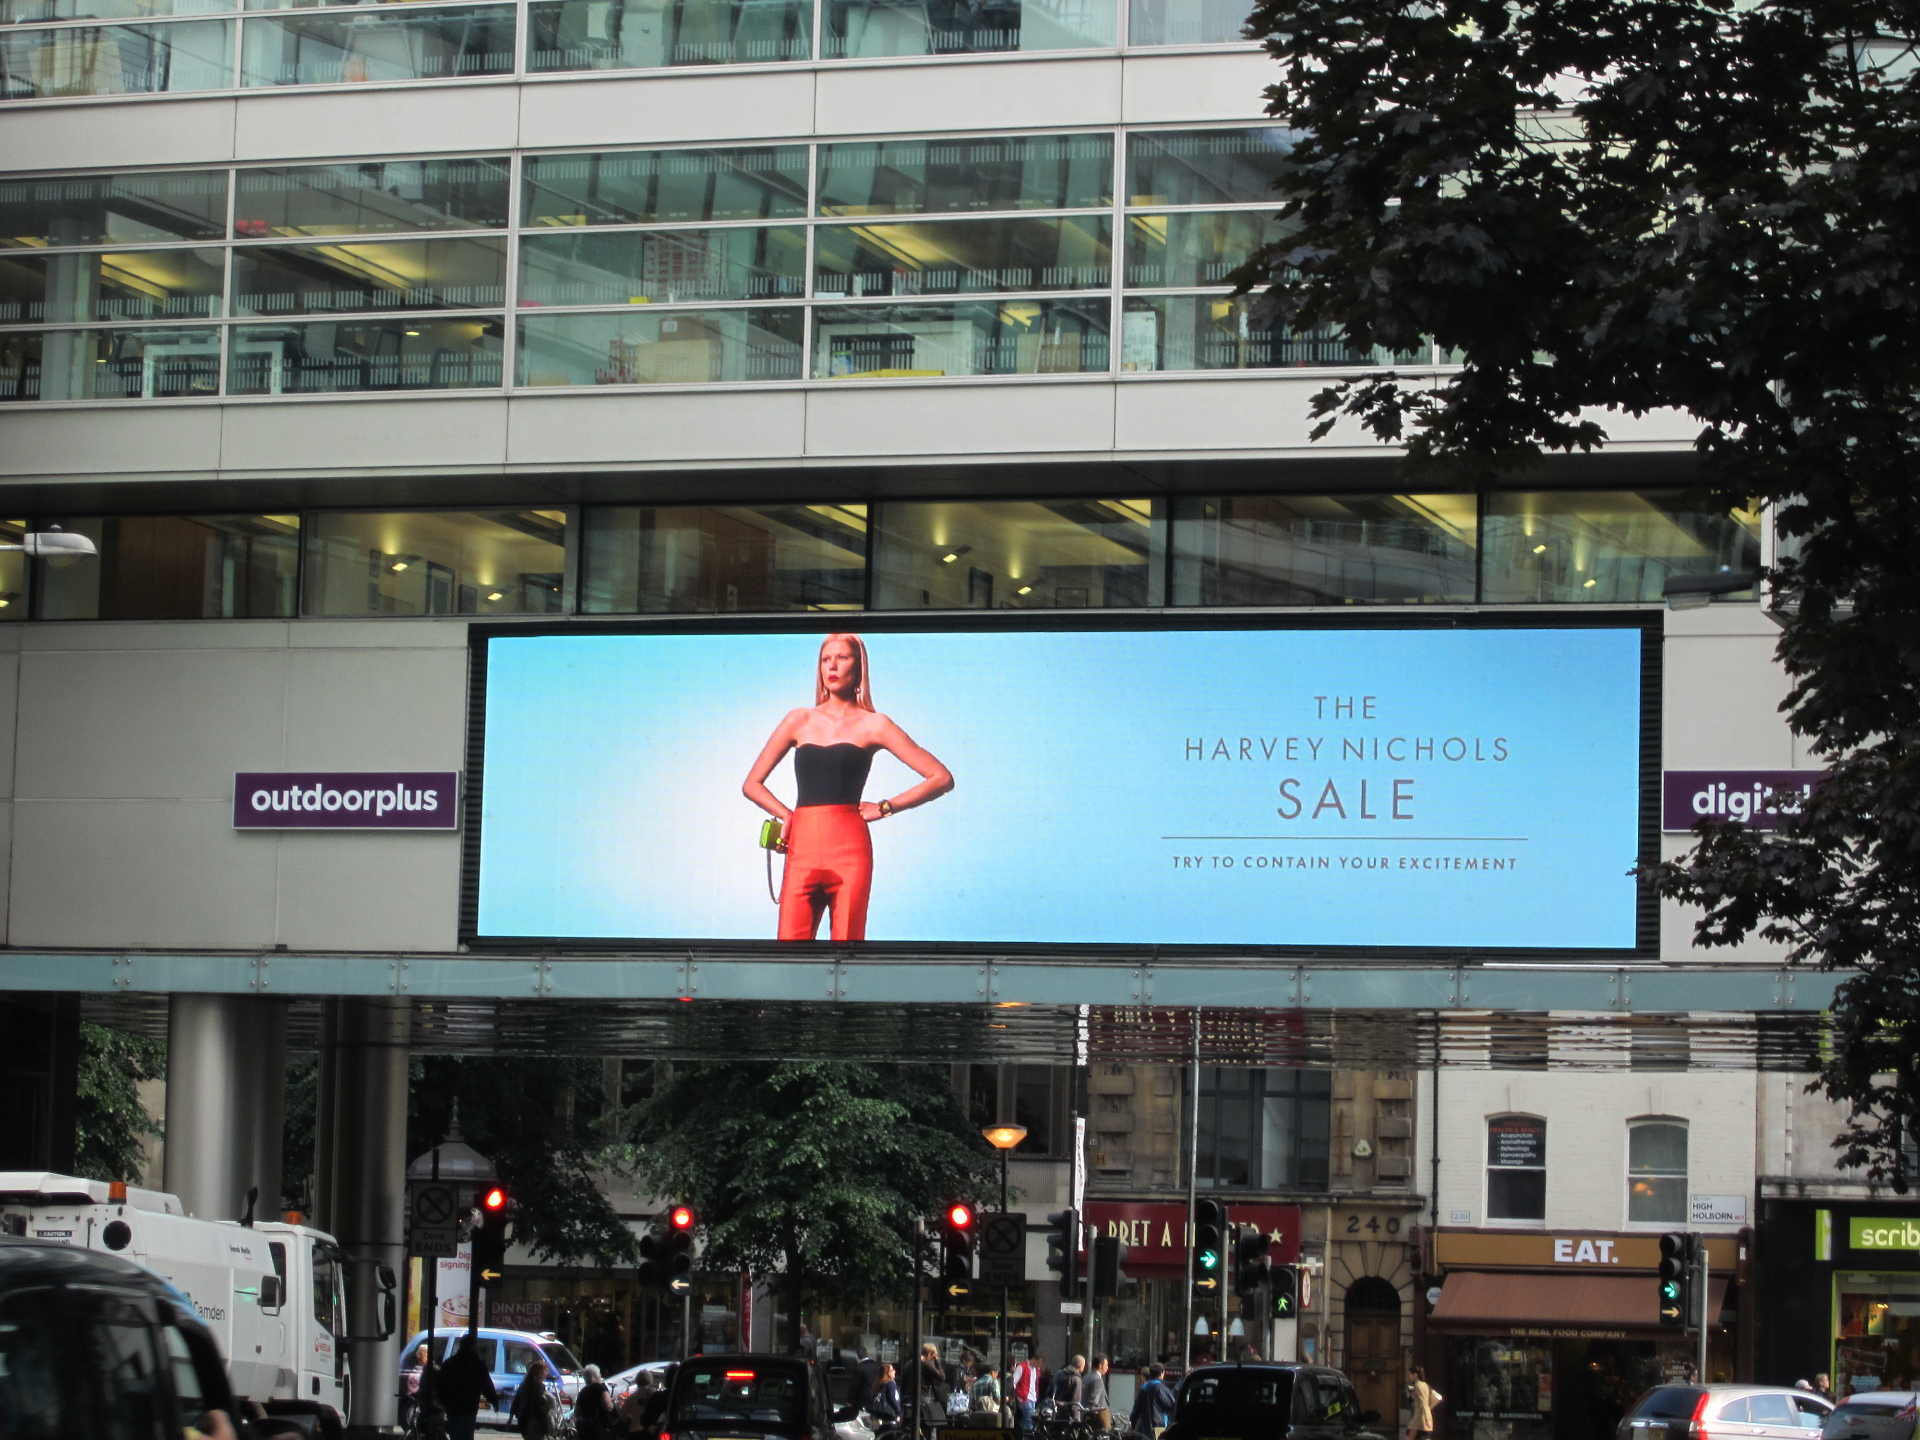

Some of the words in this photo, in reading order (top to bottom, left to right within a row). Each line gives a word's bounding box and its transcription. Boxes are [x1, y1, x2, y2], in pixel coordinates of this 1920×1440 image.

[1314, 696, 1377, 720] THE
[1185, 737, 1325, 761] HARVEY
[1343, 737, 1510, 762] NICHOLS
[251, 783, 438, 816] outdoorplus
[1276, 777, 1415, 820] SALE
[1173, 856, 1204, 869] TRY
[1212, 856, 1235, 869] TO
[1243, 856, 1330, 869] CONTAIN
[1339, 857, 1390, 869] YOUR
[1399, 857, 1517, 871] EXCITEMENT
[1692, 1212, 1733, 1220] HOLBORN
[1347, 1216, 1400, 1234] 240
[423, 1231, 445, 1240] Zone
[1109, 1220, 1150, 1247] PRET
[1161, 1221, 1172, 1247] A
[1861, 1221, 1920, 1247] scrib
[415, 1242, 452, 1253] ENDS
[1554, 1239, 1619, 1264] EAT.
[458, 1251, 471, 1261] big
[440, 1261, 470, 1271] signing
[984, 1271, 1020, 1282] ENDS
[492, 1302, 542, 1315] DINNER
[1528, 1328, 1551, 1336] REAL
[1553, 1329, 1578, 1337] FOOD
[1580, 1330, 1627, 1338] COMPANY
